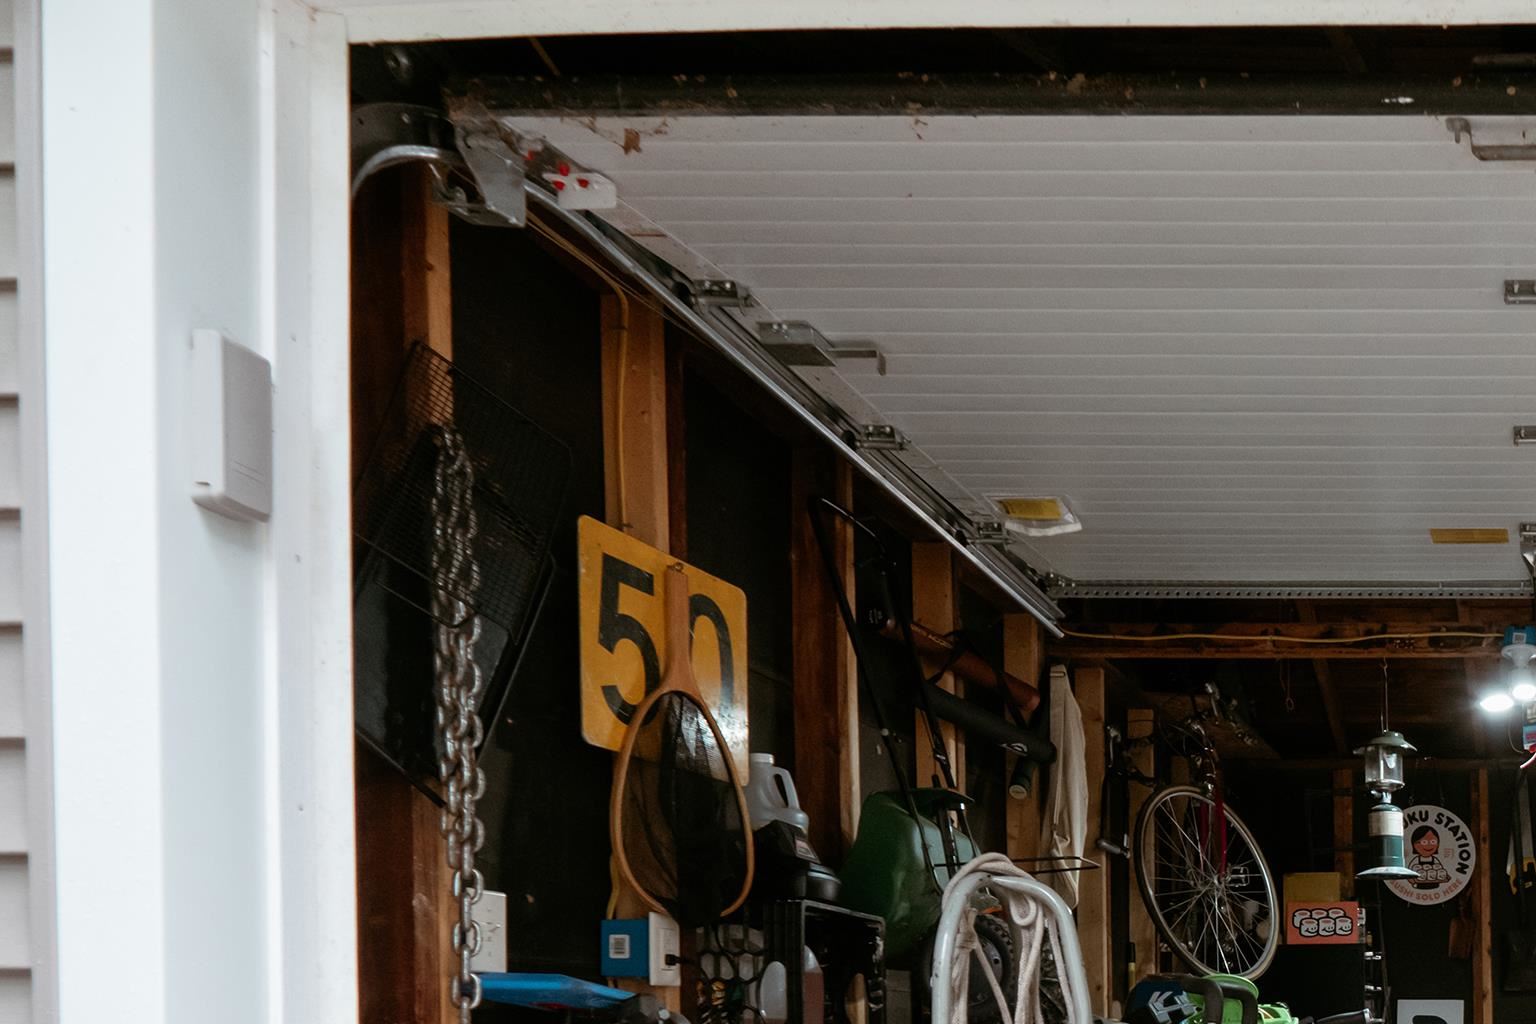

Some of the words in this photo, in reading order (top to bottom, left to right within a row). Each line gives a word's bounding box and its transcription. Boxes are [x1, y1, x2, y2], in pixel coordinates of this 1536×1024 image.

[598, 552, 735, 748] 50
[1434, 812, 1471, 875] STATION
[1416, 893, 1441, 901] SOLD
[1443, 879, 1463, 897] HERE
